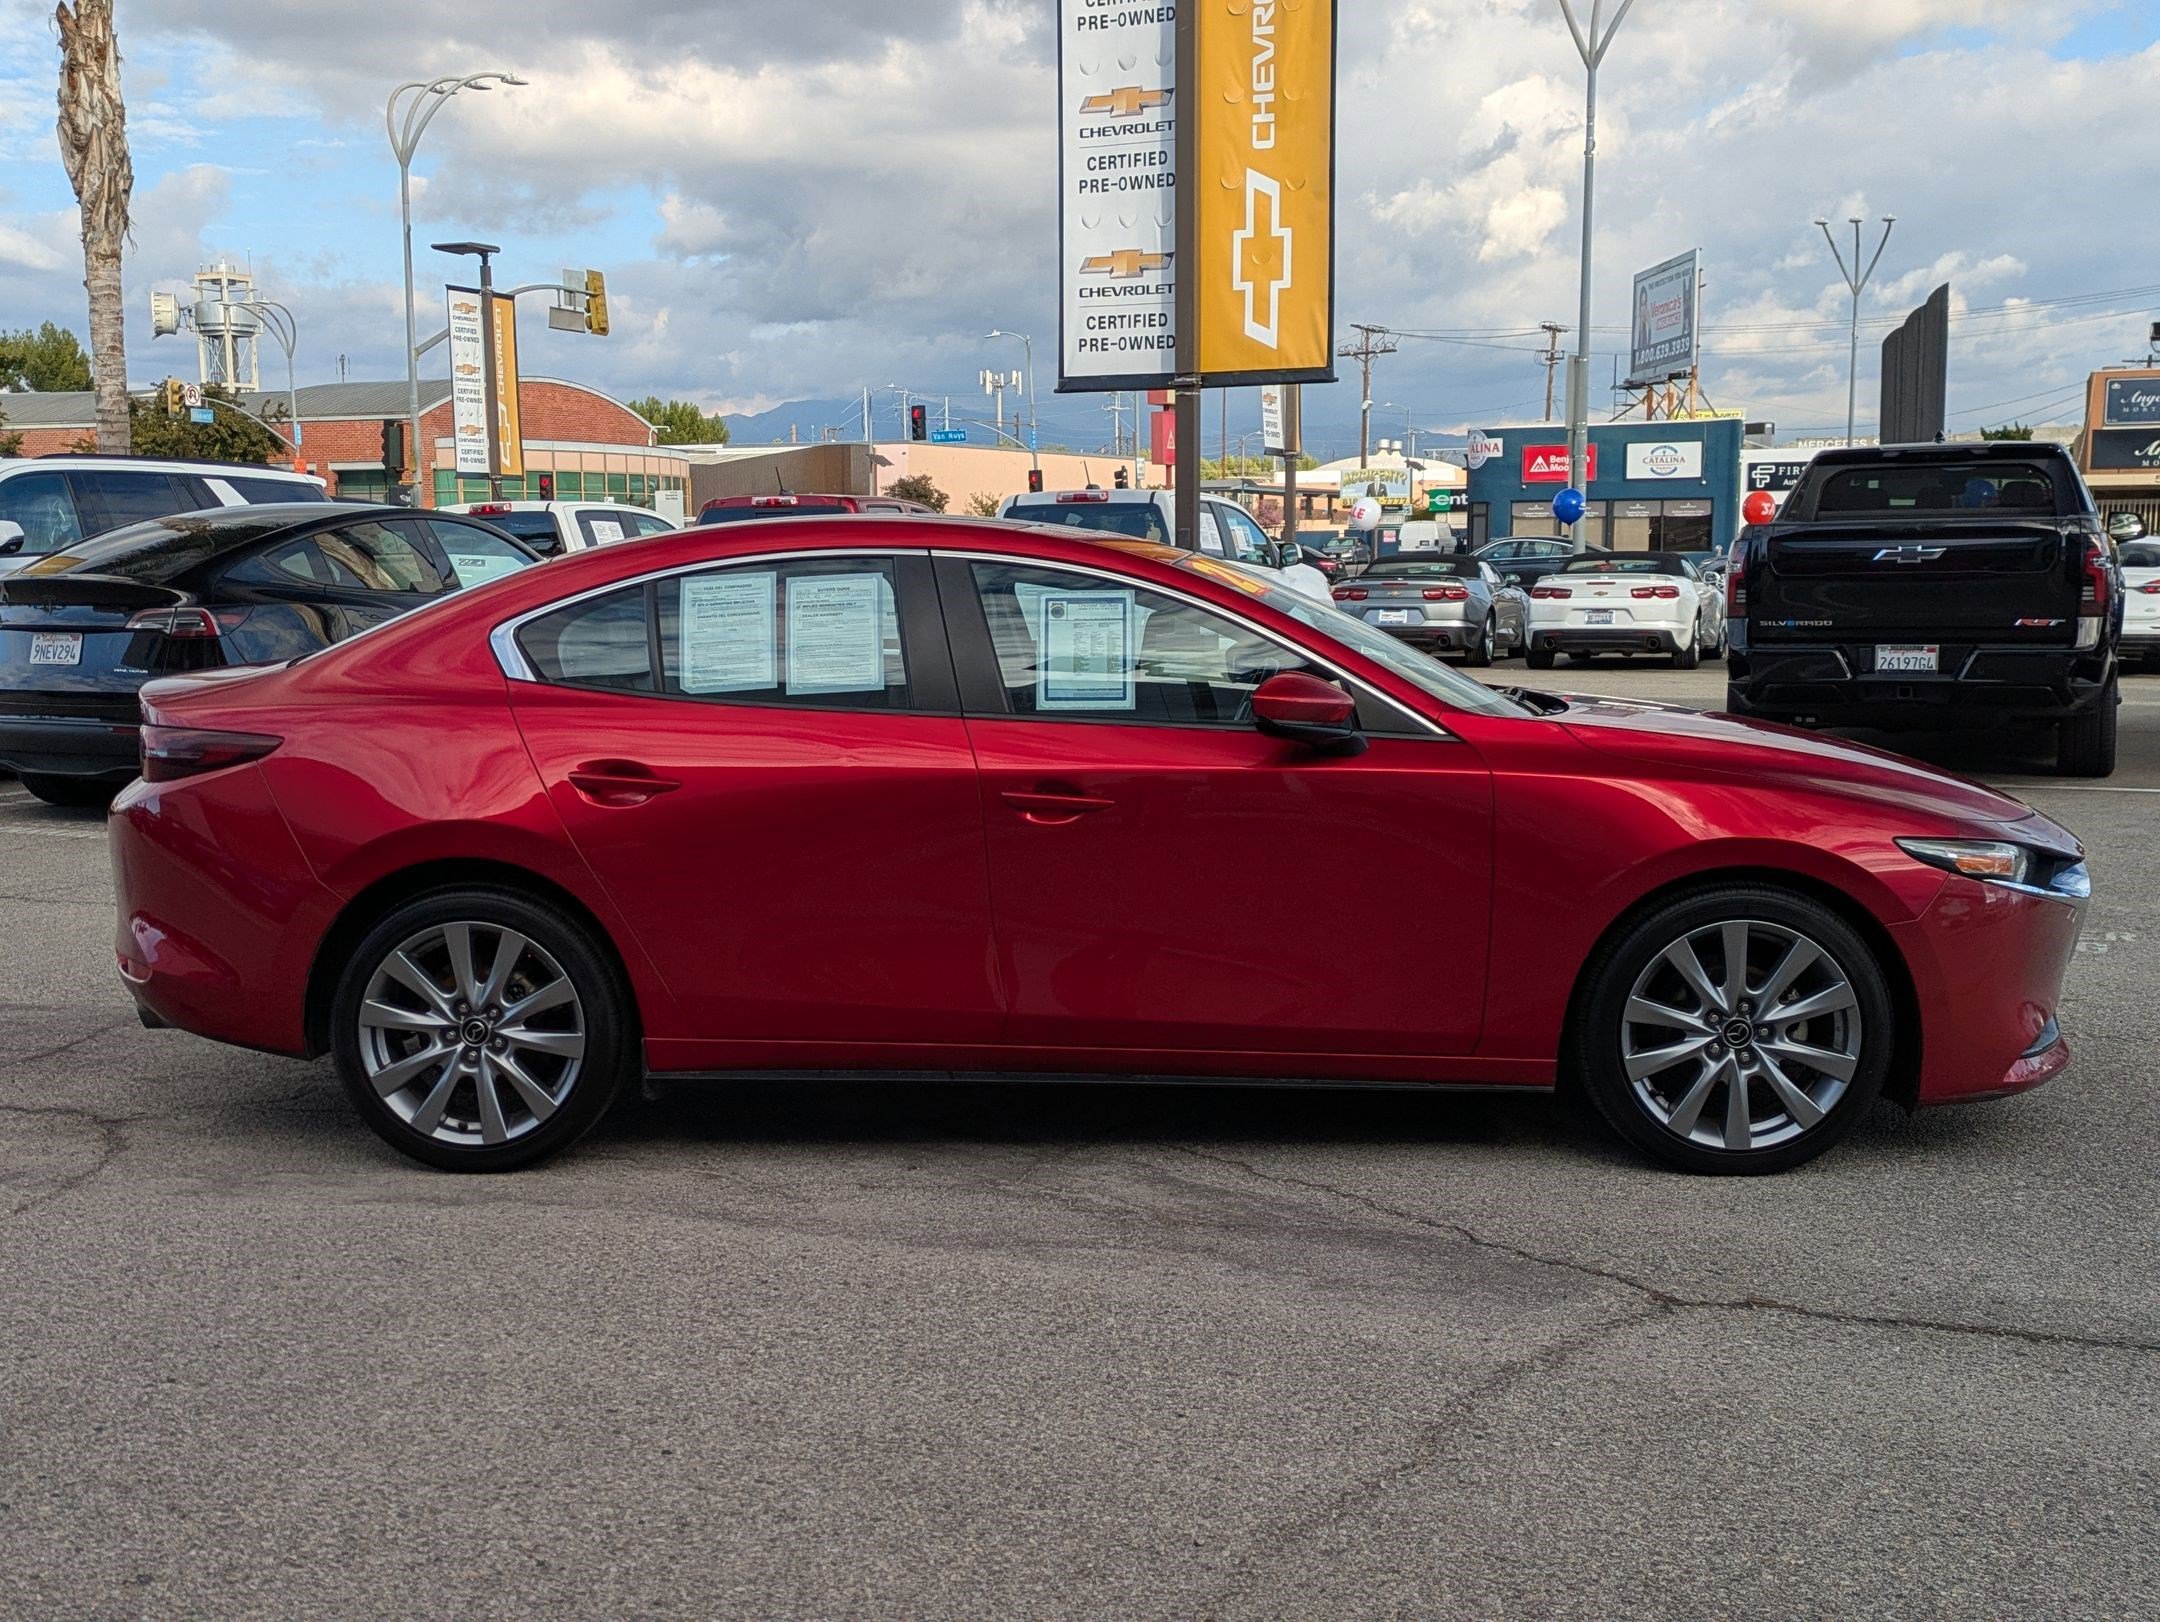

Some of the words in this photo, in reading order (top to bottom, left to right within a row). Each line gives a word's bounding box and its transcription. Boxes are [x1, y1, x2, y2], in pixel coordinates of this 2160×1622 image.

[1077, 6, 1176, 31] PRE-OWNED
[1252, 0, 1275, 150] CHEVR
[1079, 119, 1175, 139] CHEVROLET
[1086, 150, 1168, 171] CERTIFIED
[1079, 172, 1176, 194] PRE-OWNED
[1079, 283, 1175, 298] CHEVROLET
[1086, 312, 1168, 330] CERTIFIED
[452, 334, 480, 344] PRE-OWNED
[455, 326, 478, 335] CERTIFIED
[495, 307, 505, 395] CHEVROLET
[1078, 334, 1176, 352] PRE-OWNED
[932, 432, 946, 440] Van
[948, 431, 965, 440] Nuys
[1550, 464, 1570, 472] Moo
[1642, 456, 1686, 465] CATALINA
[33, 643, 76, 661] 9NEV294
[1879, 656, 1934, 669] 26197G4
